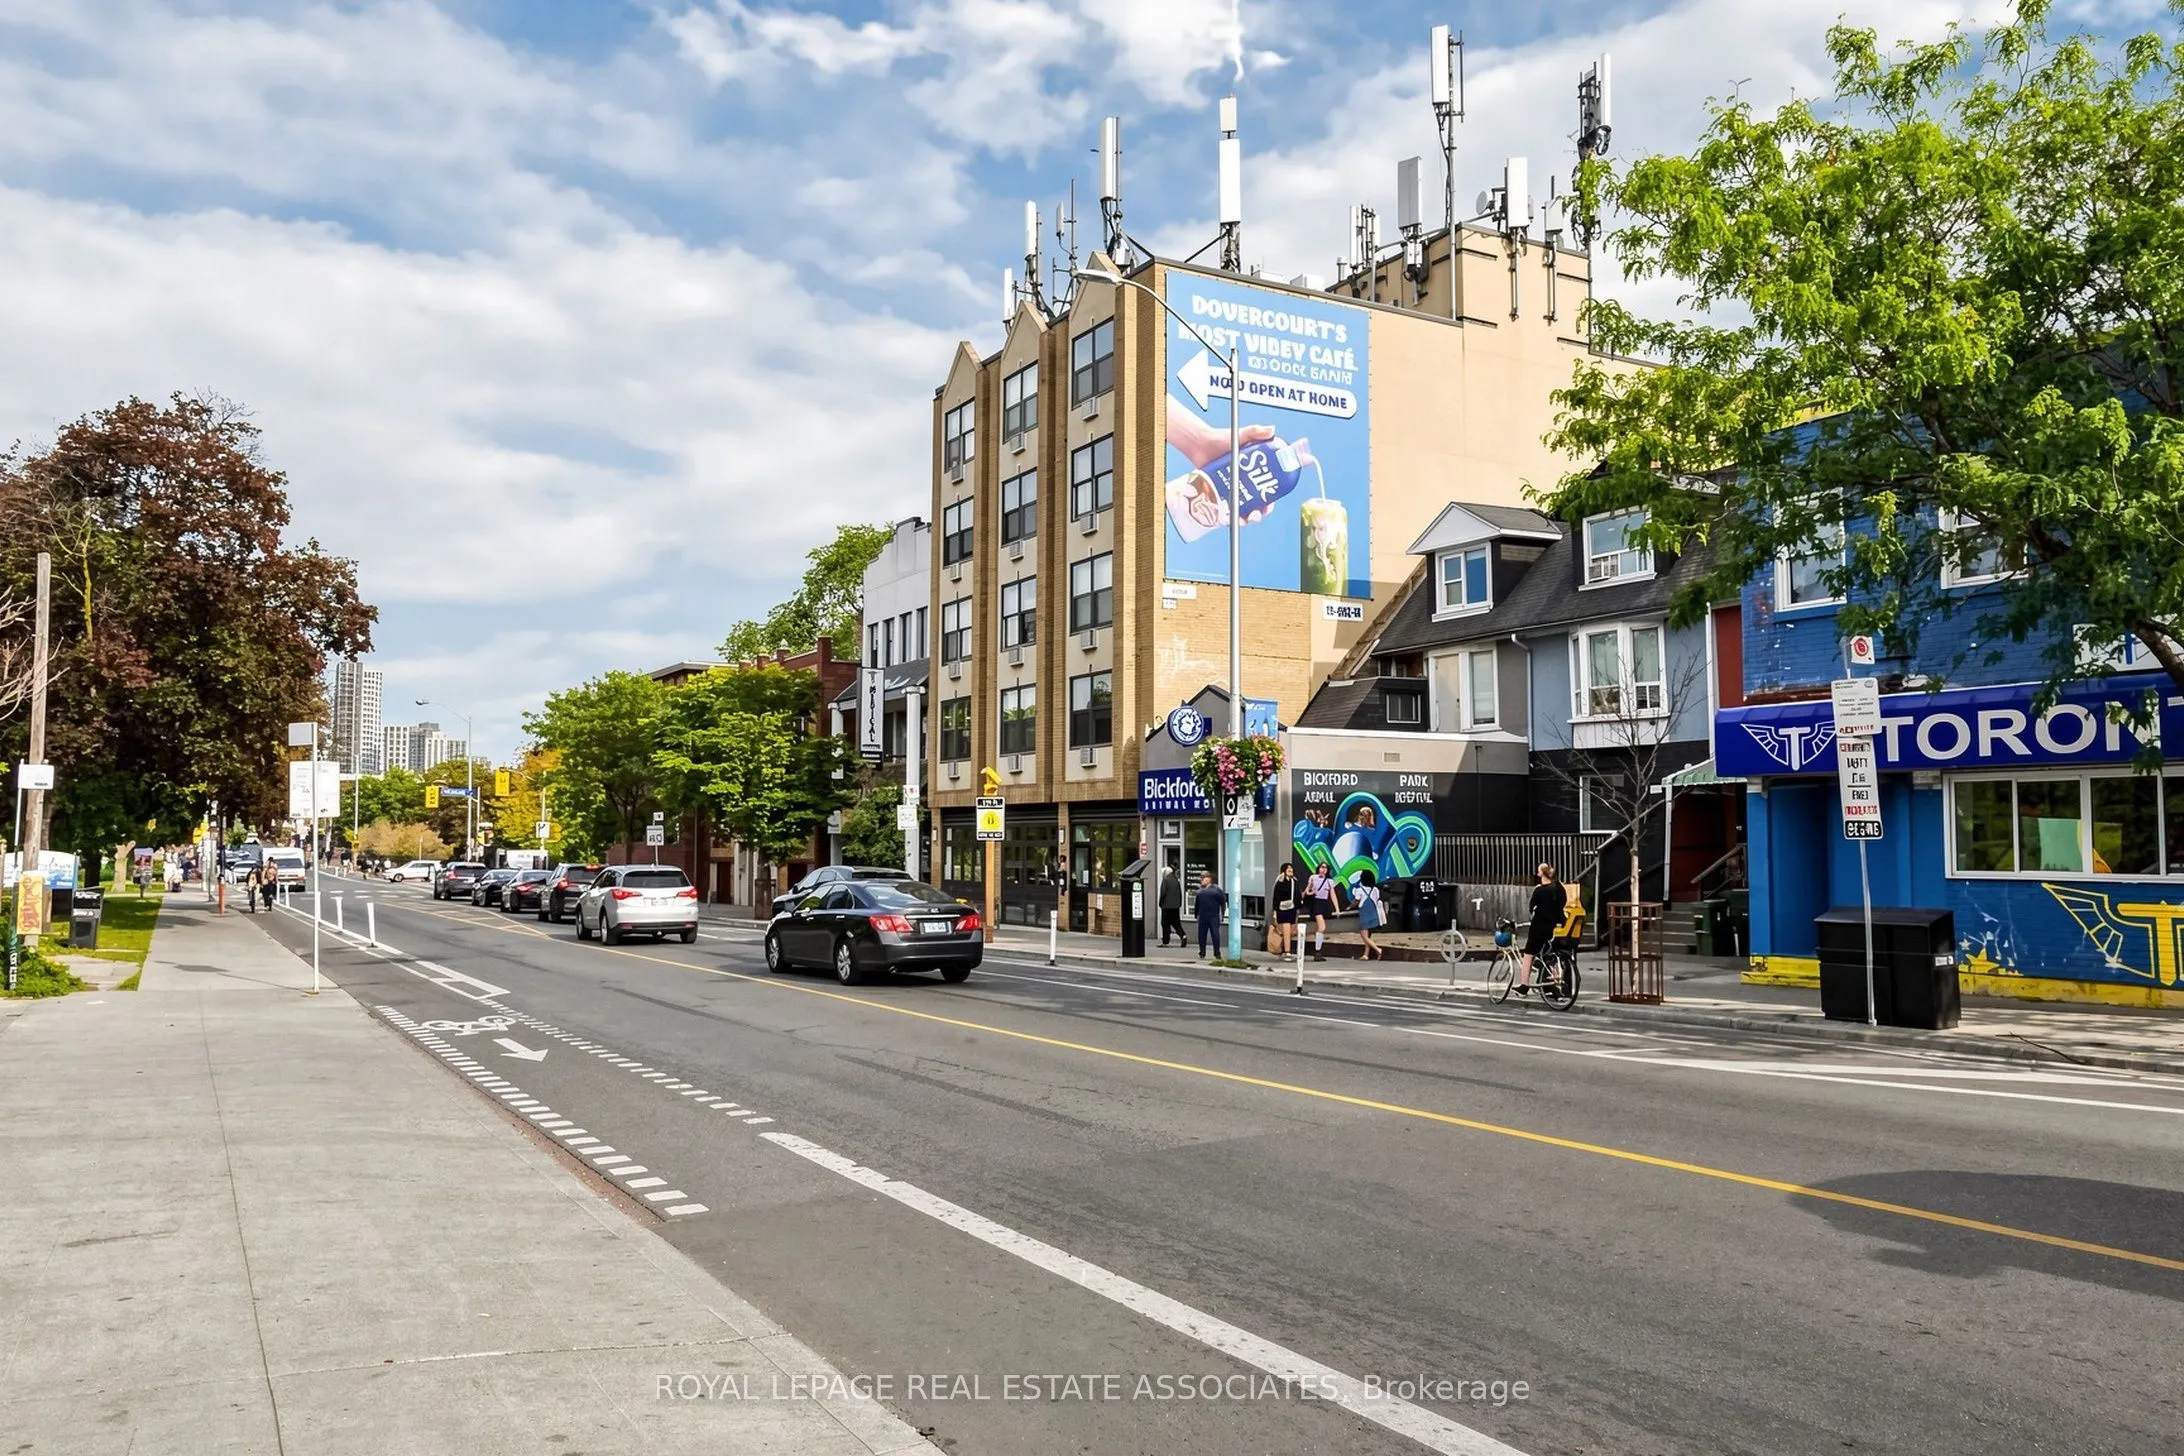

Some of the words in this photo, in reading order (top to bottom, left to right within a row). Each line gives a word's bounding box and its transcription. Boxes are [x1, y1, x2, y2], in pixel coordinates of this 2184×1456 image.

[1192, 295, 1347, 343] DOVERCOURT'S
[1178, 322, 1240, 349] MOST
[1309, 344, 1358, 372] CAFÉ
[1210, 375, 1245, 391] NO
[1249, 382, 1285, 399] OPEN
[1288, 389, 1306, 402] AT
[1309, 393, 1348, 409] HOME
[1238, 449, 1279, 503] Silk
[1880, 695, 2184, 762] TORON
